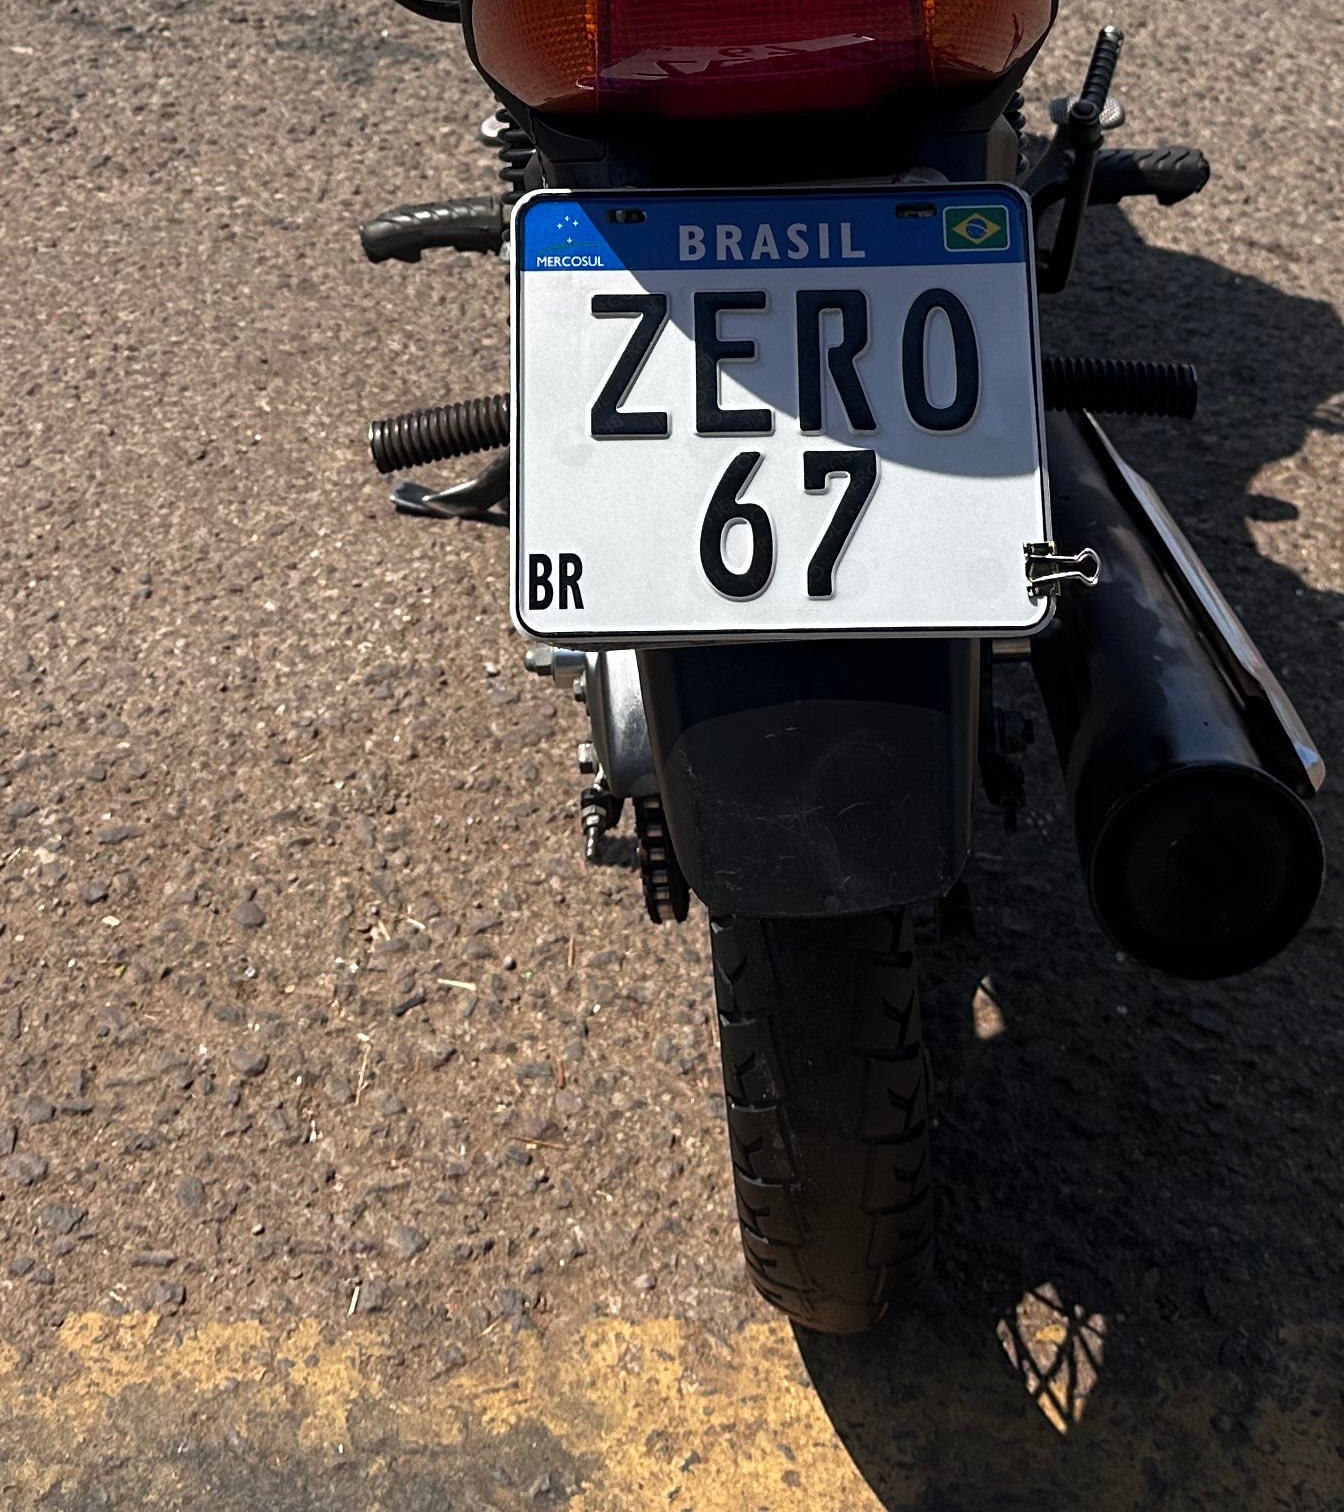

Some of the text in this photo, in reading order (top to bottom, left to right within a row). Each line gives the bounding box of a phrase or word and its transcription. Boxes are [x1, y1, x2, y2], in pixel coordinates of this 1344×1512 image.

[537, 256, 605, 268] MERCOSUL
[679, 222, 866, 261] BRASIL
[590, 287, 980, 439] ZERO
[699, 450, 878, 600] 67
[528, 553, 585, 610] BR
